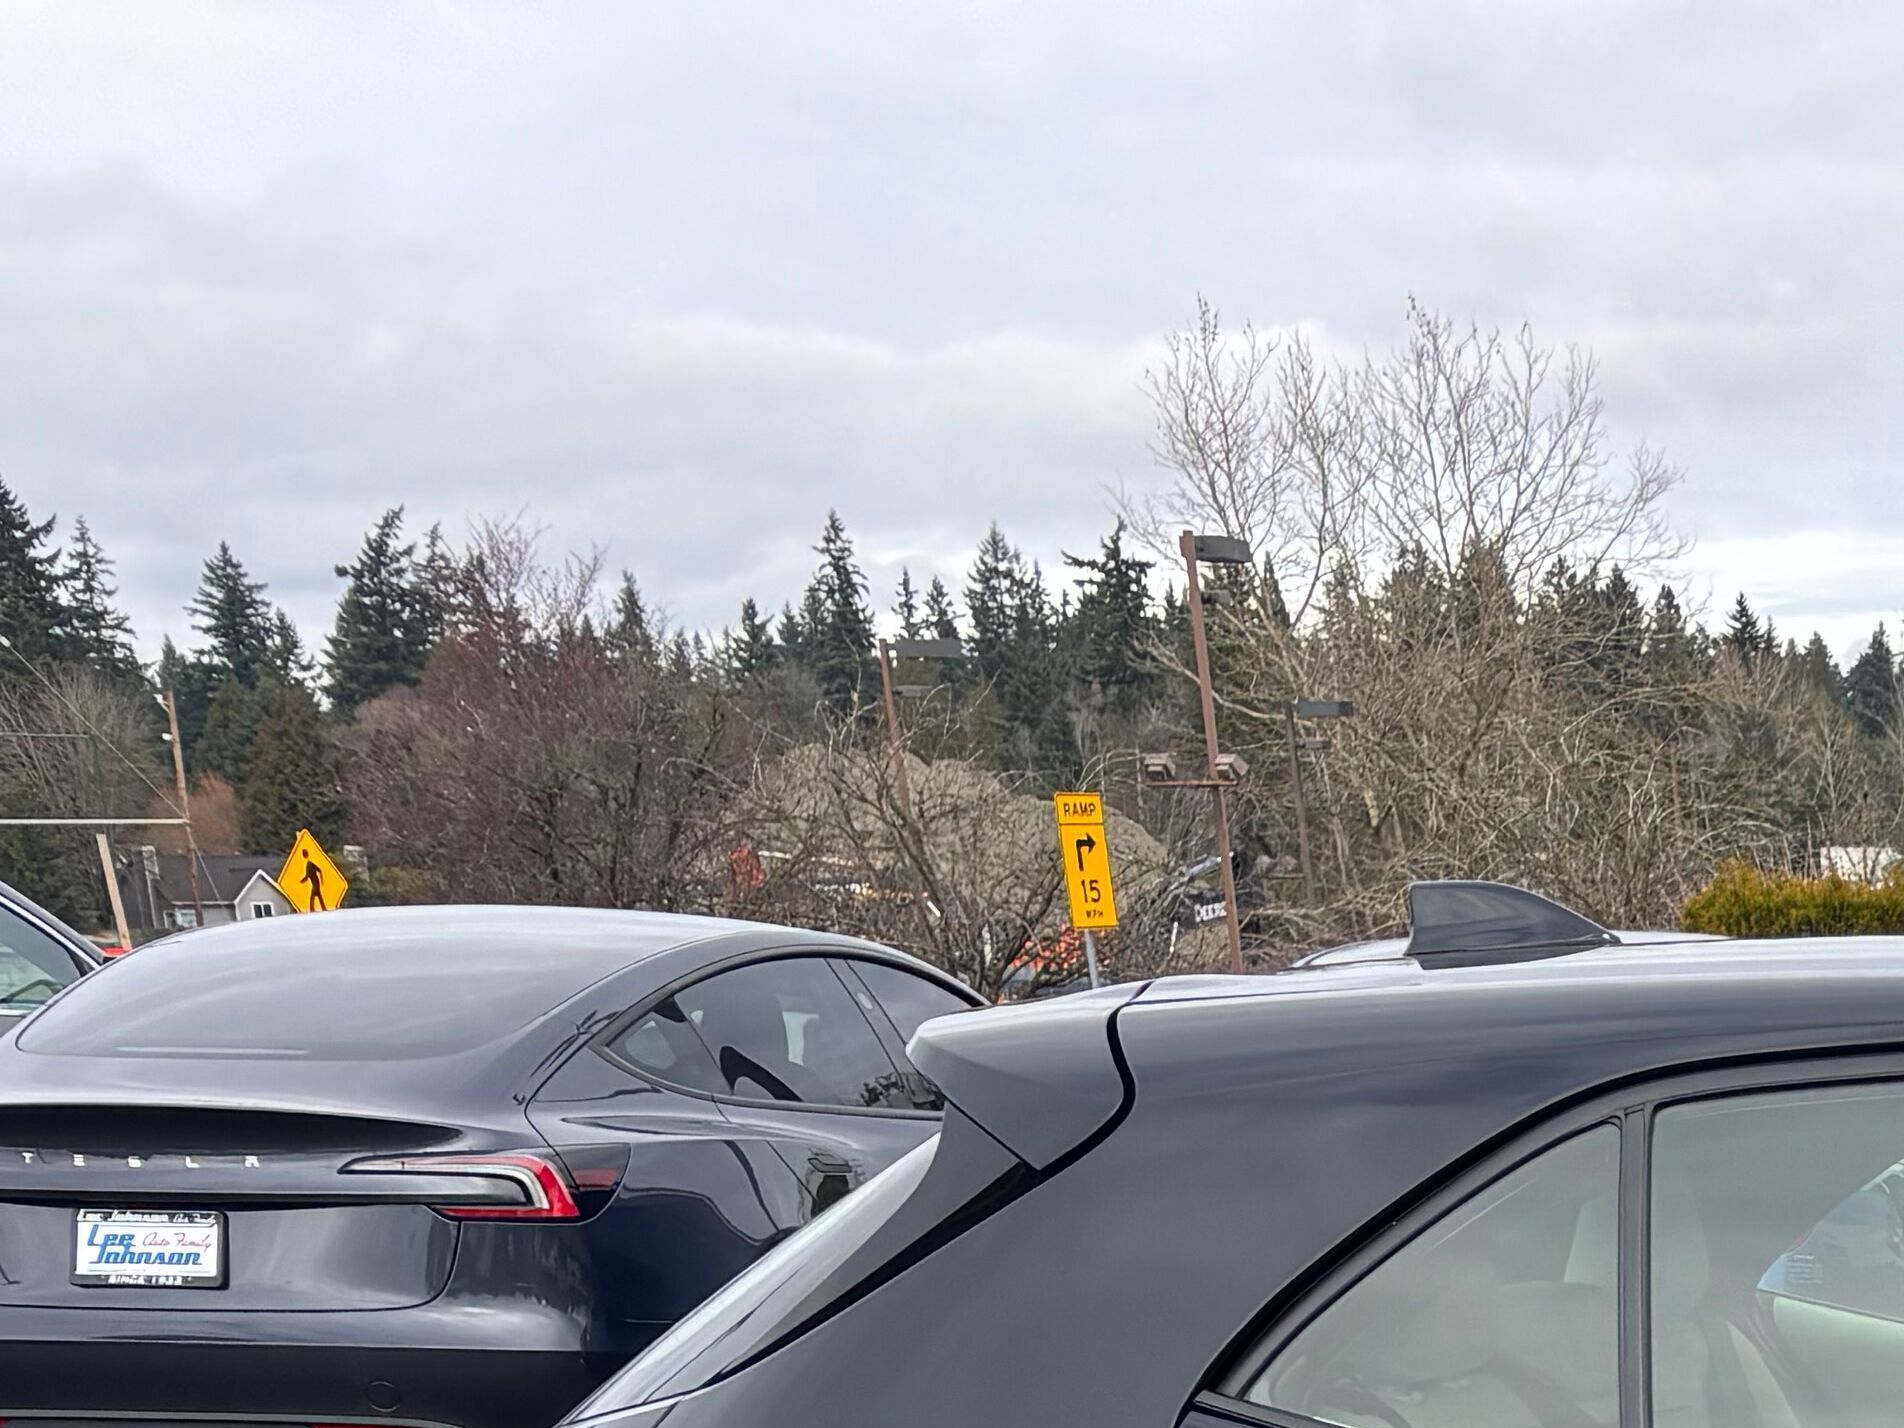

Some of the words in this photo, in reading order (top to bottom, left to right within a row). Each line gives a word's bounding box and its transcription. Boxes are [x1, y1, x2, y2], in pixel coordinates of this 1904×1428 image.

[1063, 802, 1097, 817] RAMP
[1080, 879, 1101, 904] 15
[1085, 909, 1104, 919] MPH
[22, 1151, 260, 1169] TESLA
[87, 1224, 137, 1247] Lee
[88, 1245, 204, 1266] Johnson
